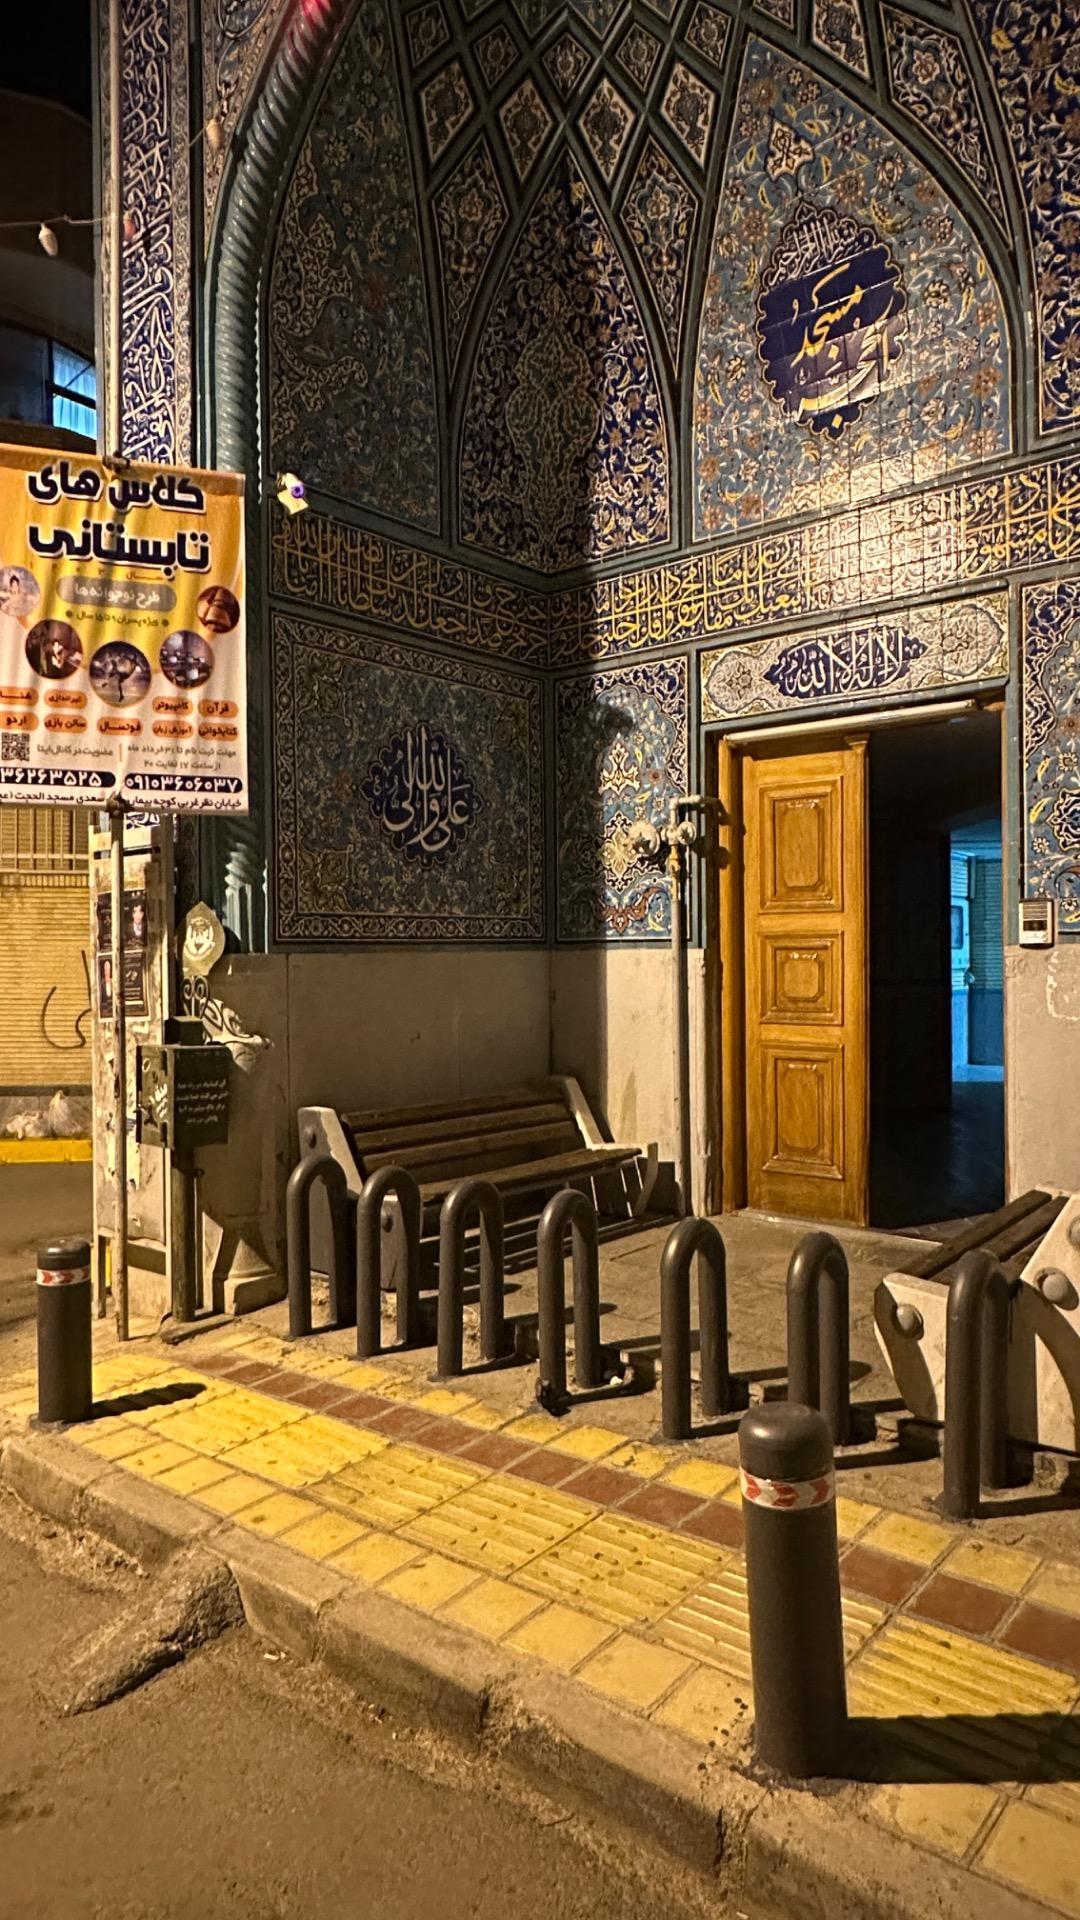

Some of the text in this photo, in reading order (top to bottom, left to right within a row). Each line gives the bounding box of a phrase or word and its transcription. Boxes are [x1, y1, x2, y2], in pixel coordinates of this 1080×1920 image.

[788, 284, 865, 369] مسجد
[28, 461, 204, 511] کلاس های
[29, 520, 210, 577] تابستانی
[136, 590, 161, 609] طرح
[156, 702, 189, 712] کامپیوتر
[206, 702, 230, 714] قرآن
[6, 716, 27, 726] اردو
[44, 718, 86, 729] سالن بازی
[99, 721, 141, 732] فوتسال
[198, 726, 238, 738] کتابخوانی
[216, 747, 236, 758] مهلت
[125, 775, 239, 793] ۰۹۱۰۳۶۰۶۰۳۷
[15, 792, 45, 804] الحجت
[47, 792, 75, 804] مسجد
[154, 797, 177, 811] کوچه
[176, 798, 200, 809] غربی
[200, 799, 214, 809] نظر
[214, 799, 242, 810] خیابان
